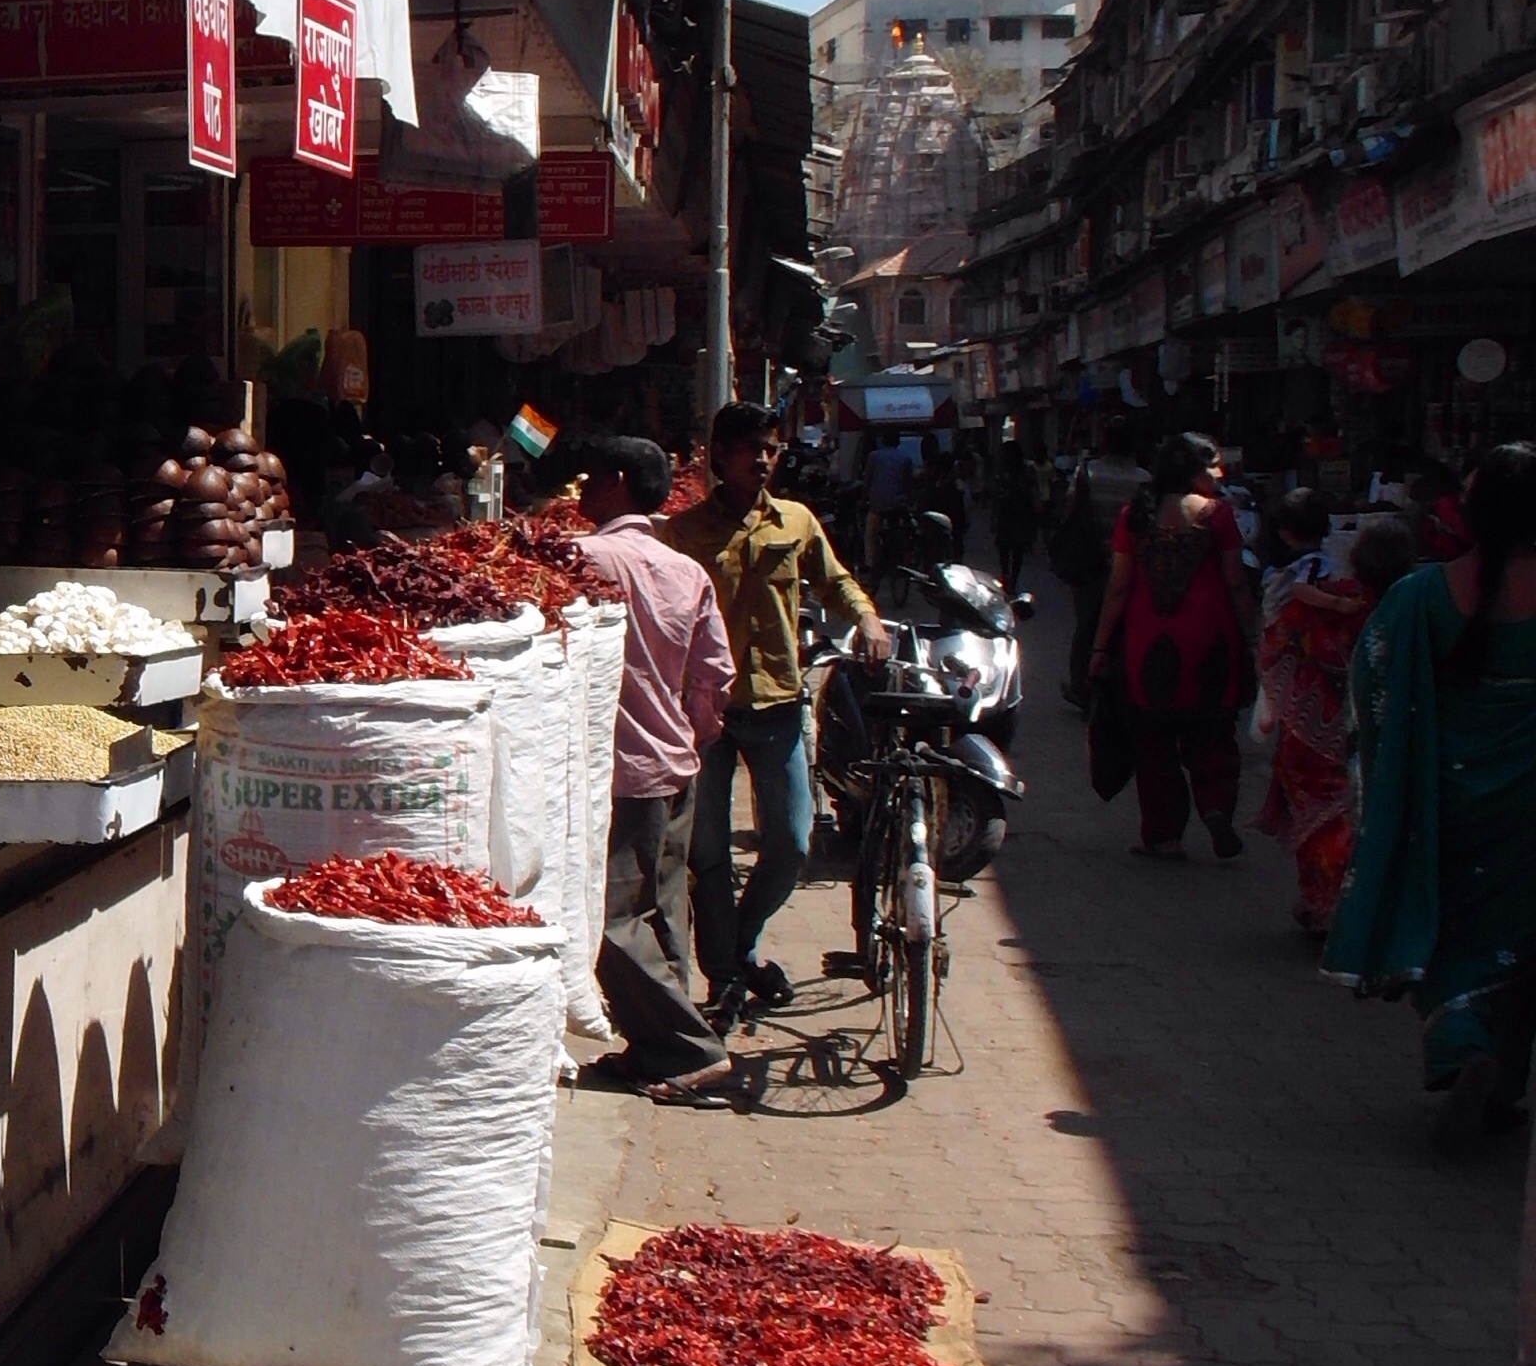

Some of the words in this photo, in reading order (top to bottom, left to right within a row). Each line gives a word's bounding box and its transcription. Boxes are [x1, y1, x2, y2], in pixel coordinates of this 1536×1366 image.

[303, 18, 353, 93] राजापुरी
[307, 84, 346, 153] खोबरे
[221, 769, 325, 812] SUPER
